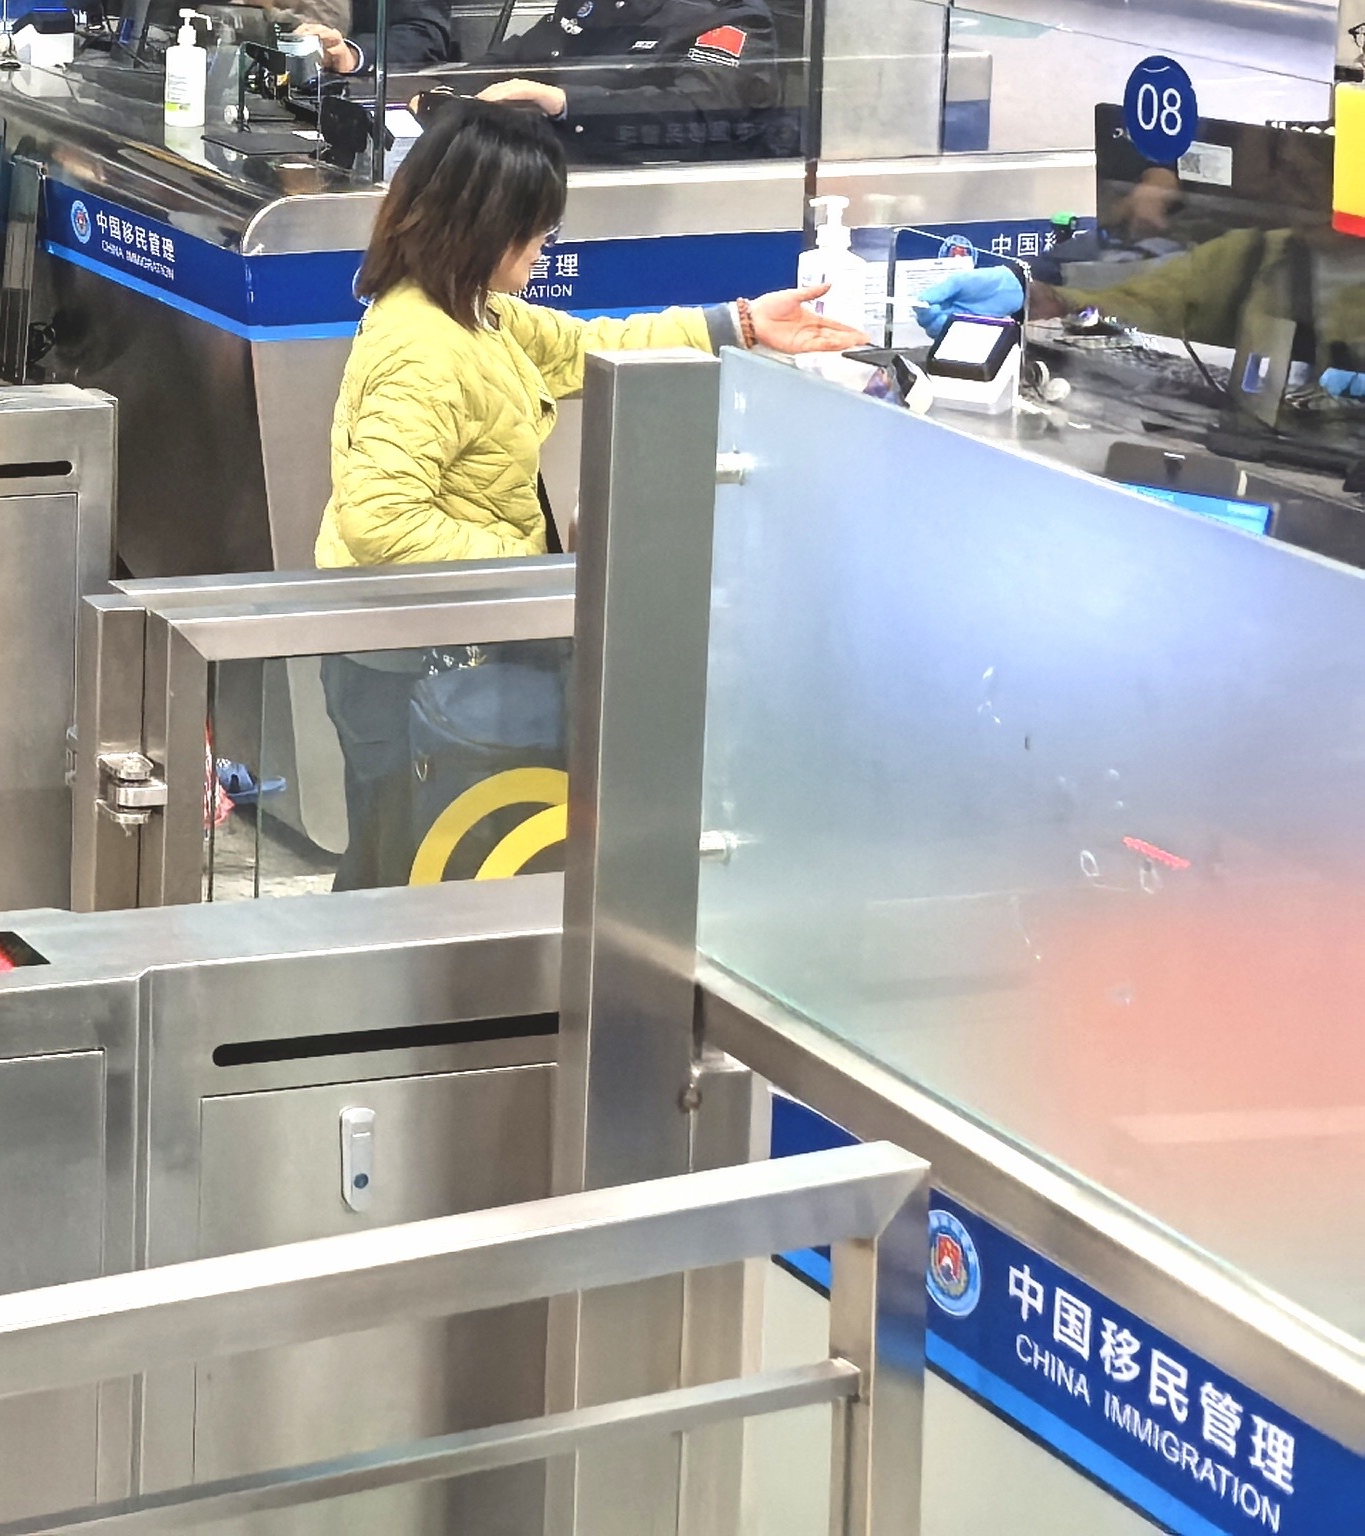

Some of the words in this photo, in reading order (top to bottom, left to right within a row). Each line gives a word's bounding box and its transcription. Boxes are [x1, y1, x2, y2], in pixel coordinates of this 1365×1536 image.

[1137, 83, 1182, 136] 08
[96, 210, 175, 263] 中国移民管理
[101, 240, 124, 260] CHINA
[1008, 1265, 1295, 1495] 中国移民管理
[1016, 1334, 1091, 1406] CHINA
[1104, 1389, 1281, 1533] IMMIGRATION
